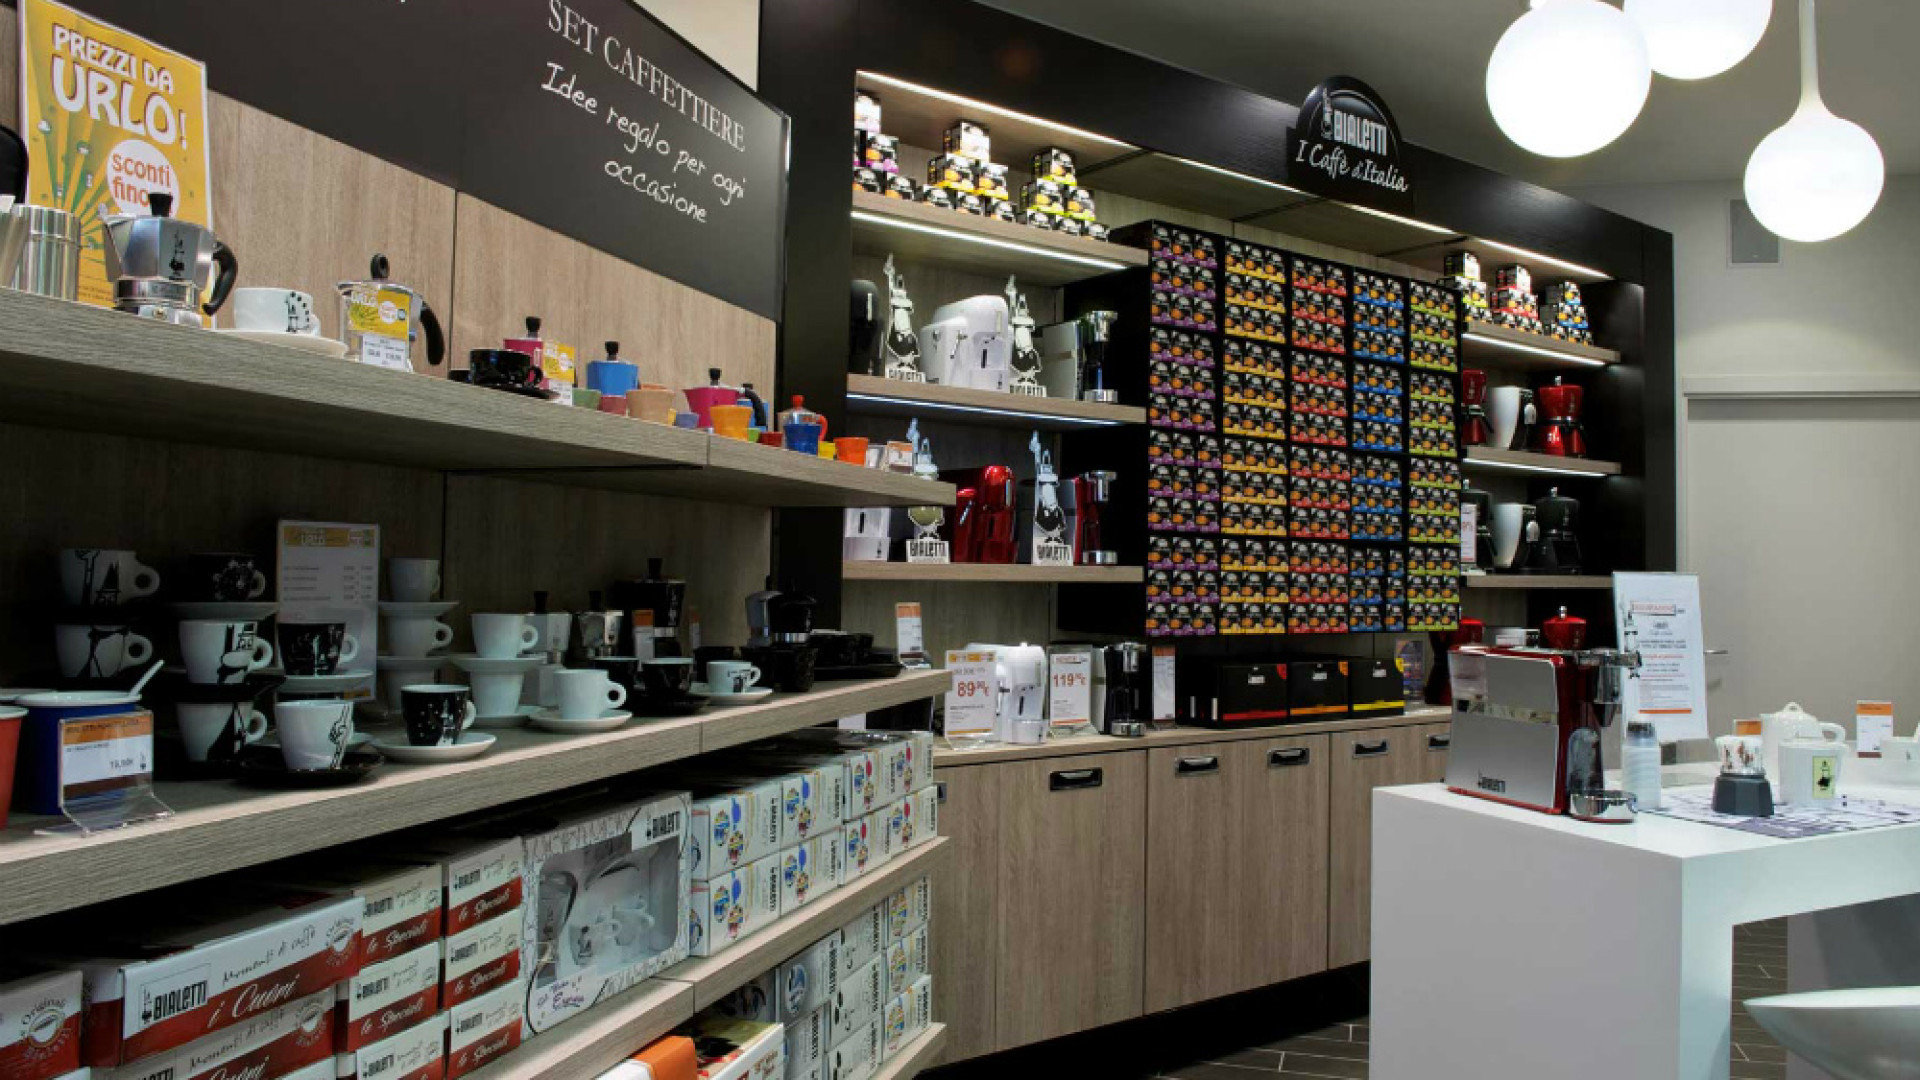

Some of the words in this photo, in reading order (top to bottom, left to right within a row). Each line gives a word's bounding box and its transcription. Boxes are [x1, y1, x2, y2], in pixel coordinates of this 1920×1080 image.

[52, 23, 136, 80] PREZZI
[143, 59, 174, 95] DA
[548, 0, 599, 55] SET
[604, 35, 746, 152] CAFFETTIERE
[52, 53, 188, 151] URLO!
[541, 61, 598, 115] Idee
[606, 106, 671, 155] regalo
[673, 150, 707, 176] per
[711, 172, 747, 206] ogni
[1333, 109, 1387, 156] BIALETTI
[112, 153, 170, 188] sconti
[604, 160, 708, 223] occasione
[1295, 139, 1310, 162] I
[1309, 143, 1351, 179] Caffè
